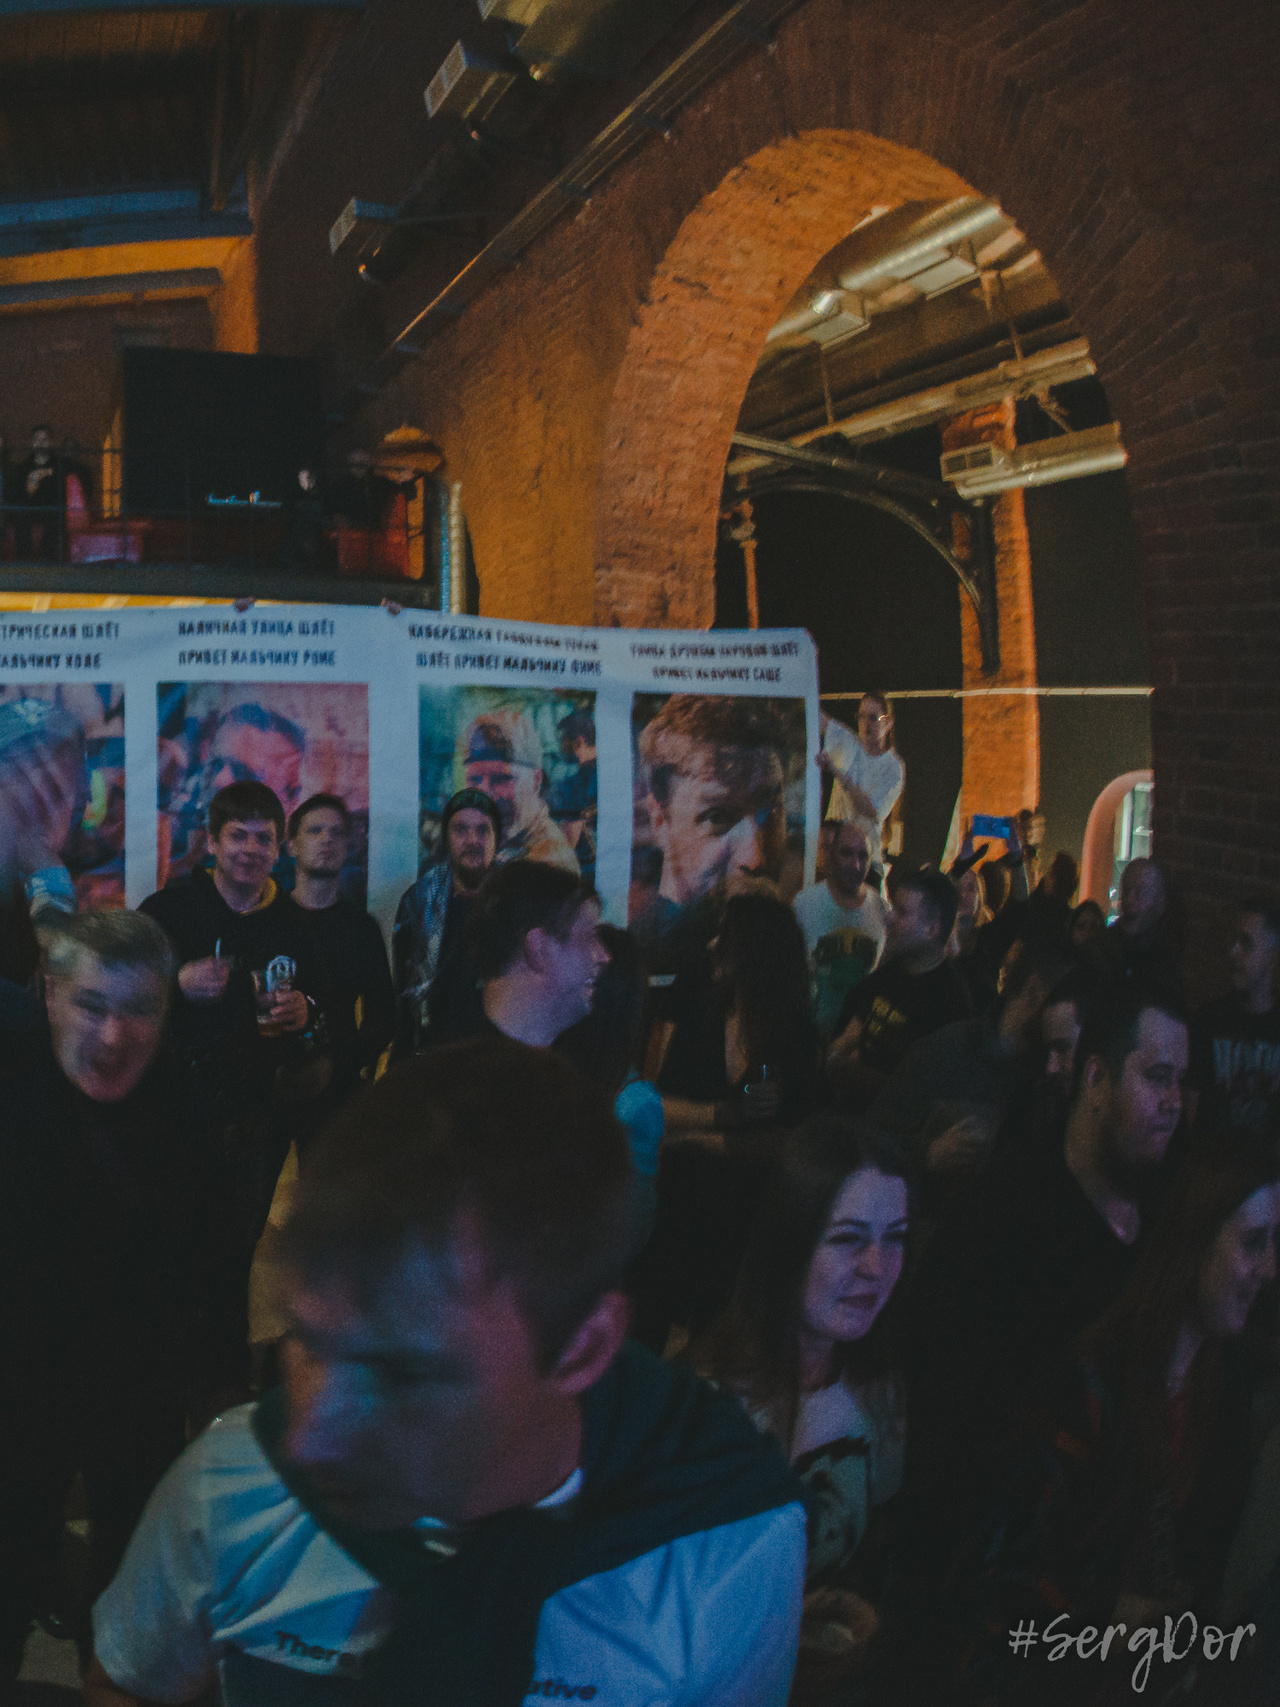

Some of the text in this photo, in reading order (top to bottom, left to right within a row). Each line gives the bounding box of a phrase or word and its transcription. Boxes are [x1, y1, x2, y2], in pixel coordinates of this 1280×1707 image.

[82, 621, 119, 639] ШЛЁТ
[178, 618, 335, 636] НАЛИЧНАЯ УЛИЦА ШЛЁТ
[408, 623, 492, 641] НАБЕРЕЖНАЯ
[65, 652, 101, 669] КОЛЕ
[178, 649, 335, 665] ПРИВЕТ МАЛЬЧИКУ РОМЕ
[416, 650, 449, 668] ШЛЁТ
[454, 653, 499, 670] ПРИВЕТ
[503, 656, 566, 673] МАЛЬЧИКУ
[753, 666, 781, 683] САШЕ
